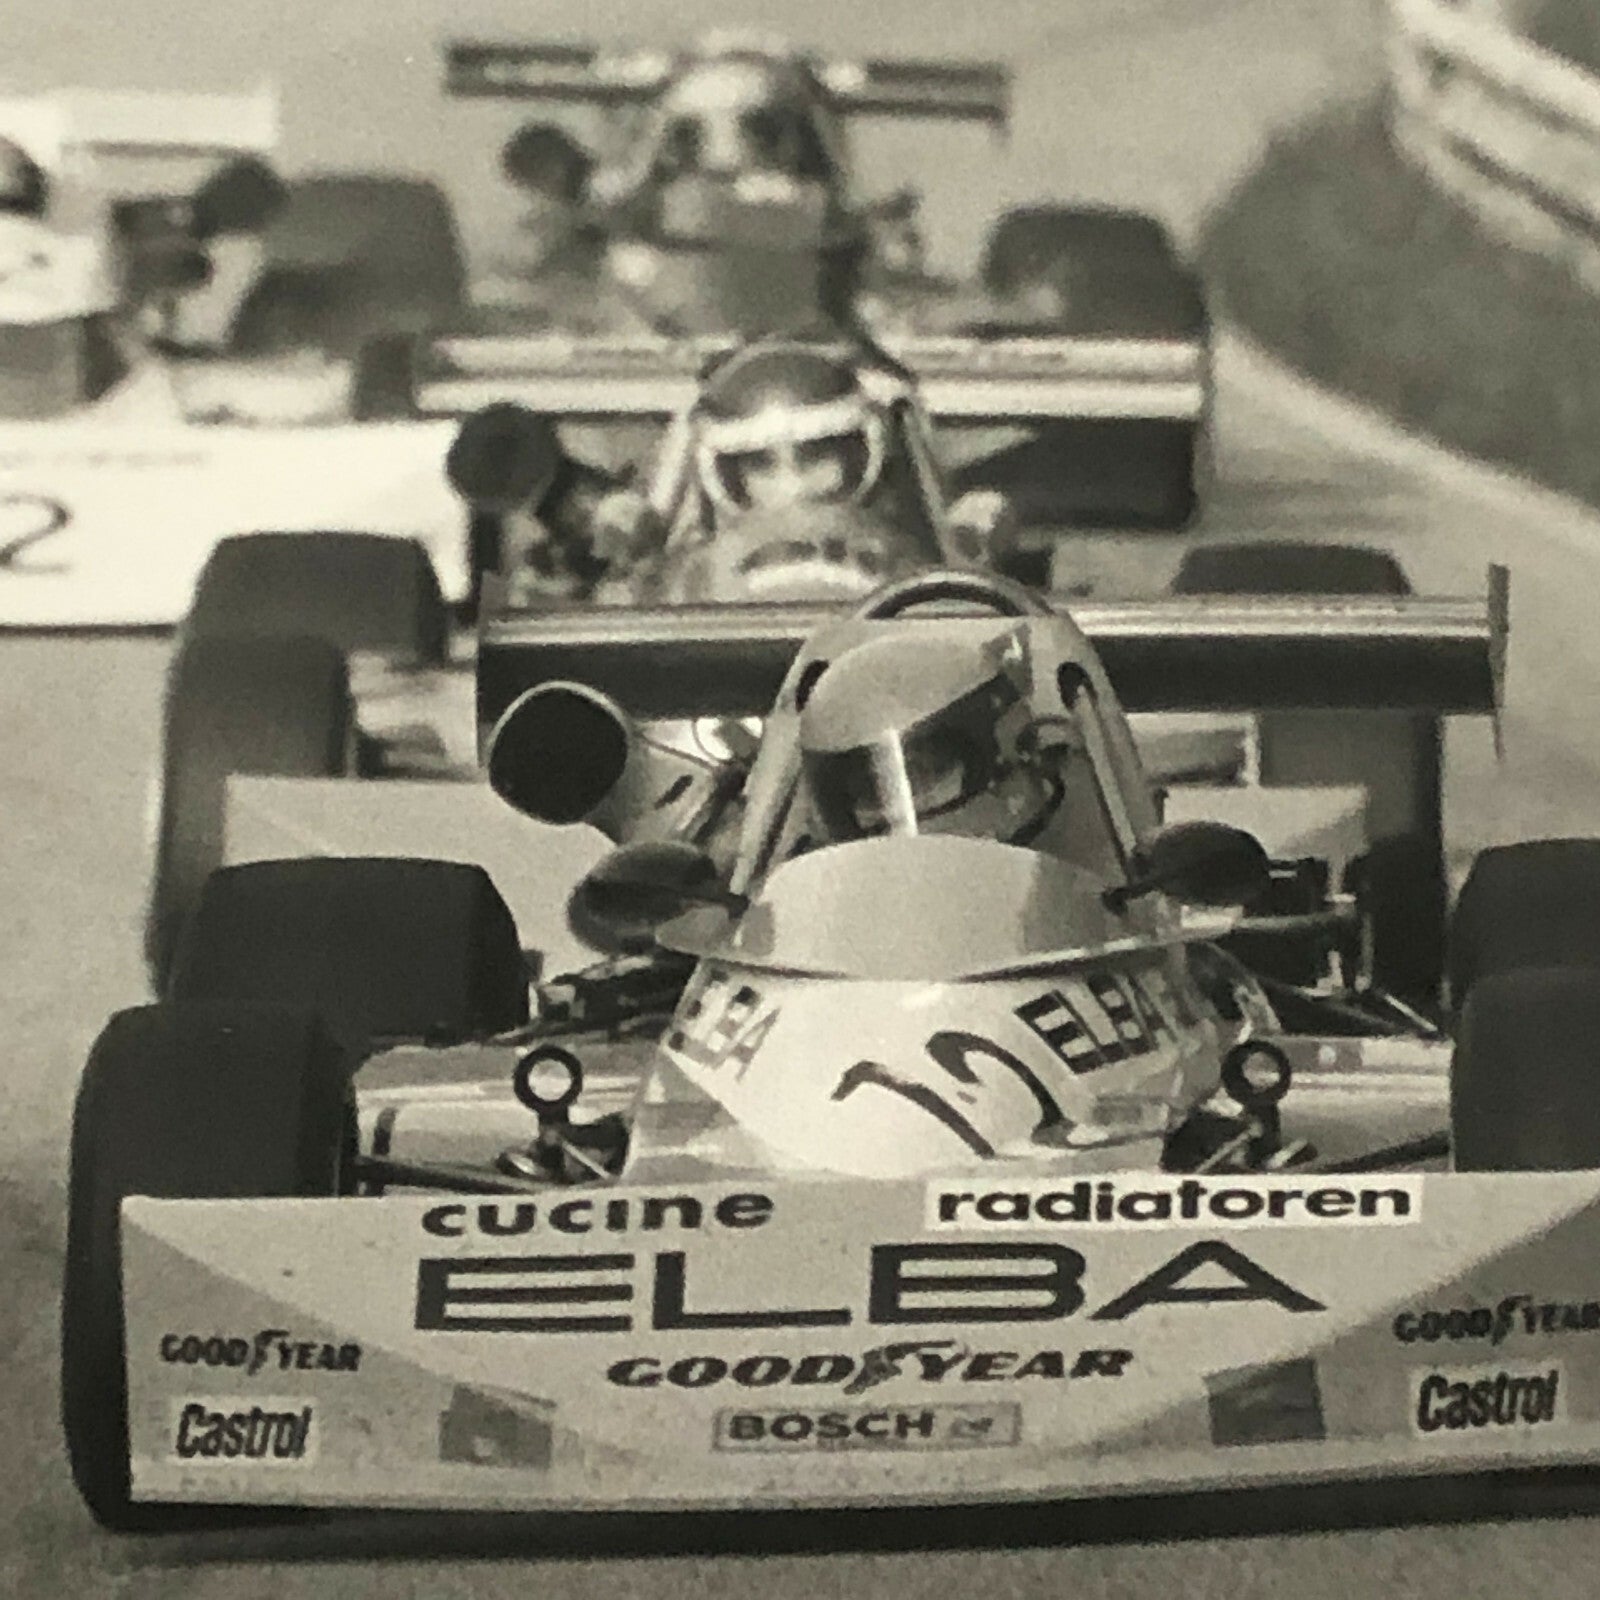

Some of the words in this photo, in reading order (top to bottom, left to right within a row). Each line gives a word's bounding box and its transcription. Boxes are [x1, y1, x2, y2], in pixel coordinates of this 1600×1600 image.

[421, 1191, 774, 1237] cucine
[938, 1178, 1412, 1224] radiatoren
[413, 1240, 1329, 1331] ELBA
[160, 1330, 361, 1376] GOODYEAR
[606, 1339, 1135, 1395] GOODYEAR
[728, 1410, 936, 1441] BOSCH
[1418, 1369, 1559, 1432] Castrol
[176, 1403, 313, 1458] Castrol
